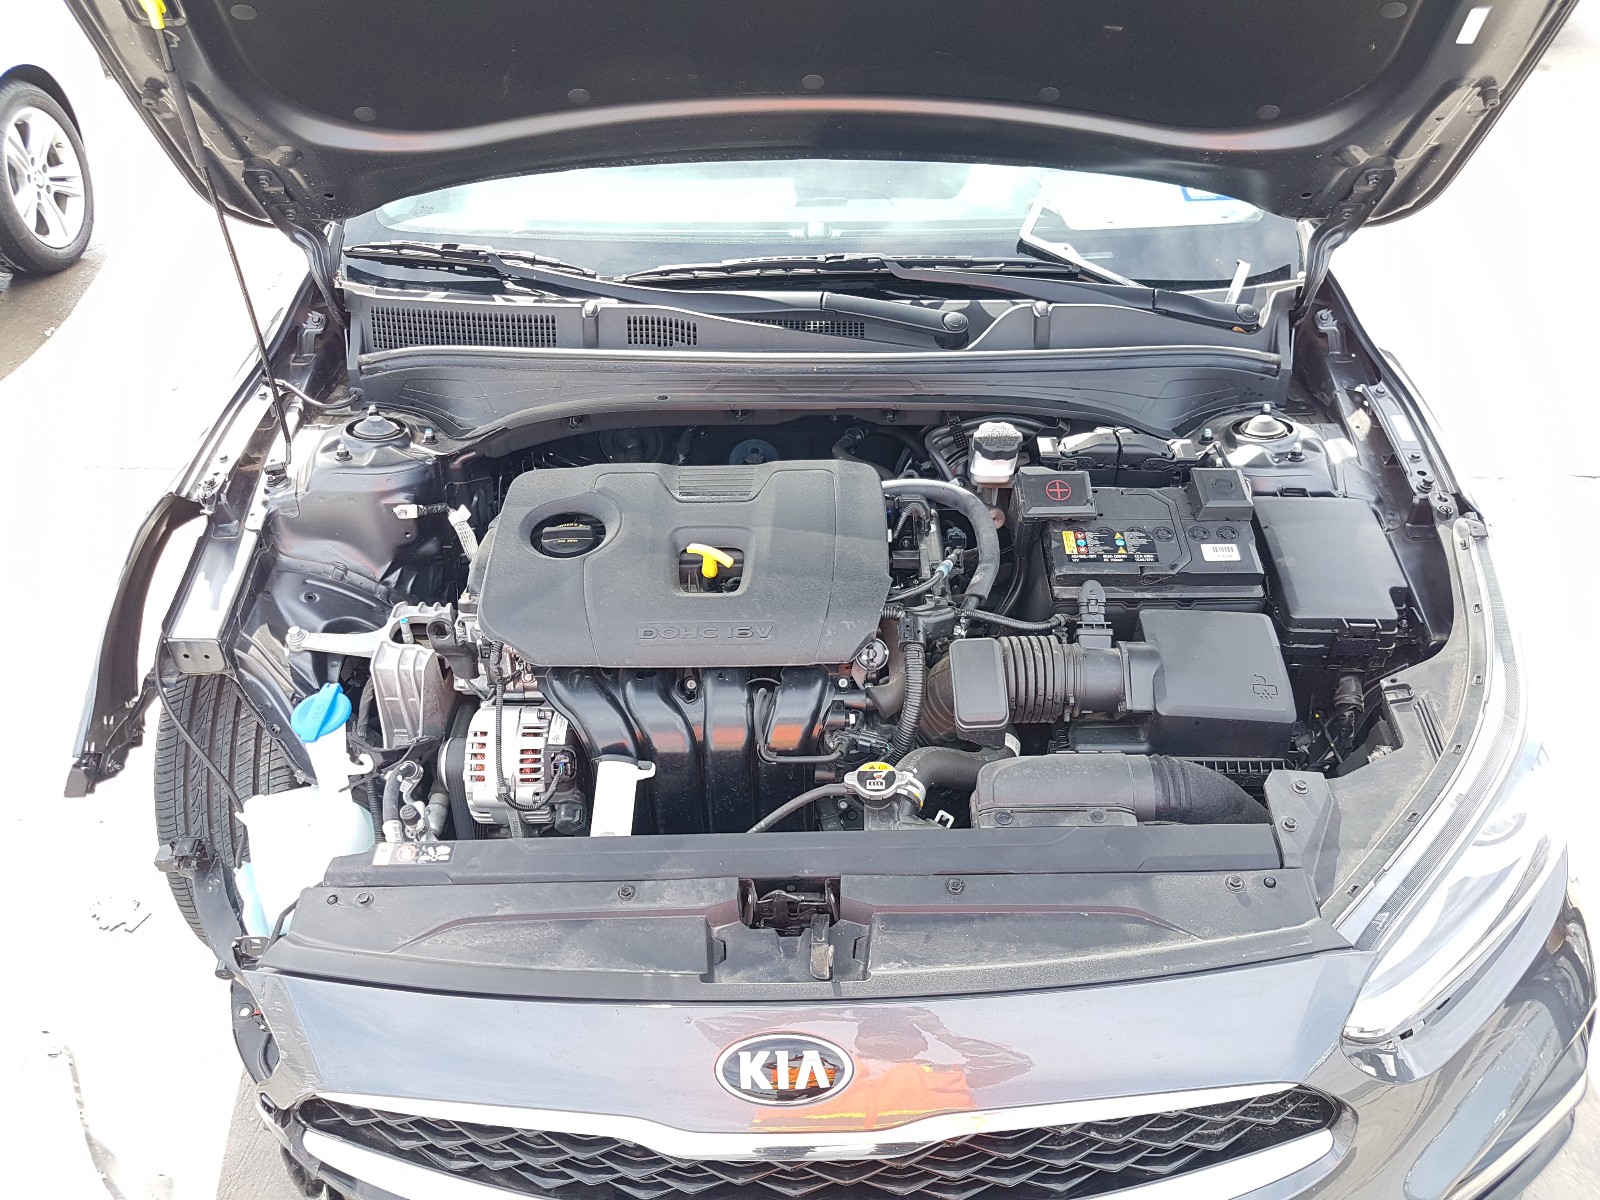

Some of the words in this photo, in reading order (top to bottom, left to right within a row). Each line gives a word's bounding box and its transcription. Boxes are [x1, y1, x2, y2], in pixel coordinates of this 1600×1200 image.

[638, 626, 719, 640] DOHC
[727, 625, 775, 639] 16V
[738, 1050, 831, 1090] KIA
